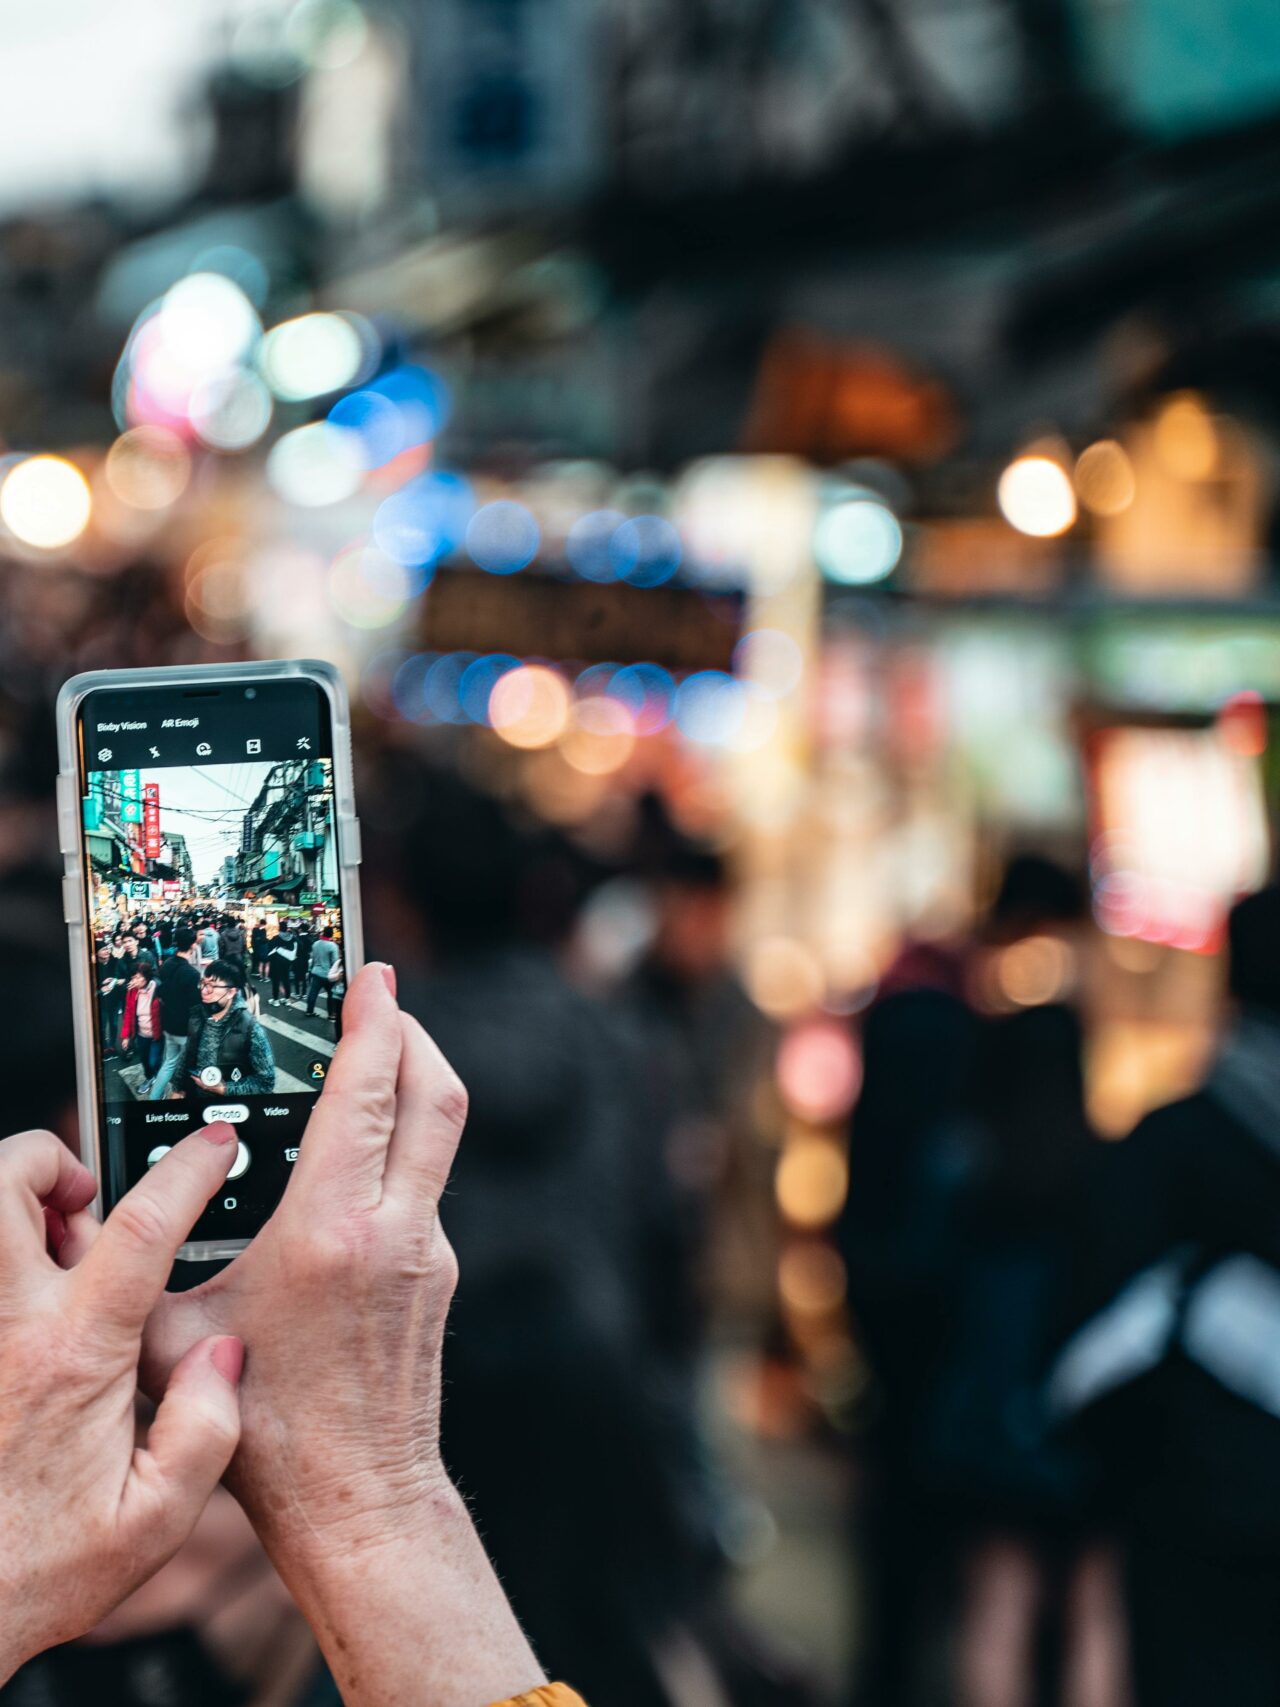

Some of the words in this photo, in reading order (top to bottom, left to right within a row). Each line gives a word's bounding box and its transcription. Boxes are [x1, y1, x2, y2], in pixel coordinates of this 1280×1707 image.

[97, 722, 120, 733] Bixby
[121, 721, 147, 730] Vision
[161, 719, 174, 728] AR
[175, 717, 199, 729] Emoji
[145, 1113, 164, 1123] Live
[164, 1112, 190, 1122] focus
[211, 1109, 241, 1120] Photo
[263, 1107, 290, 1117] Video
